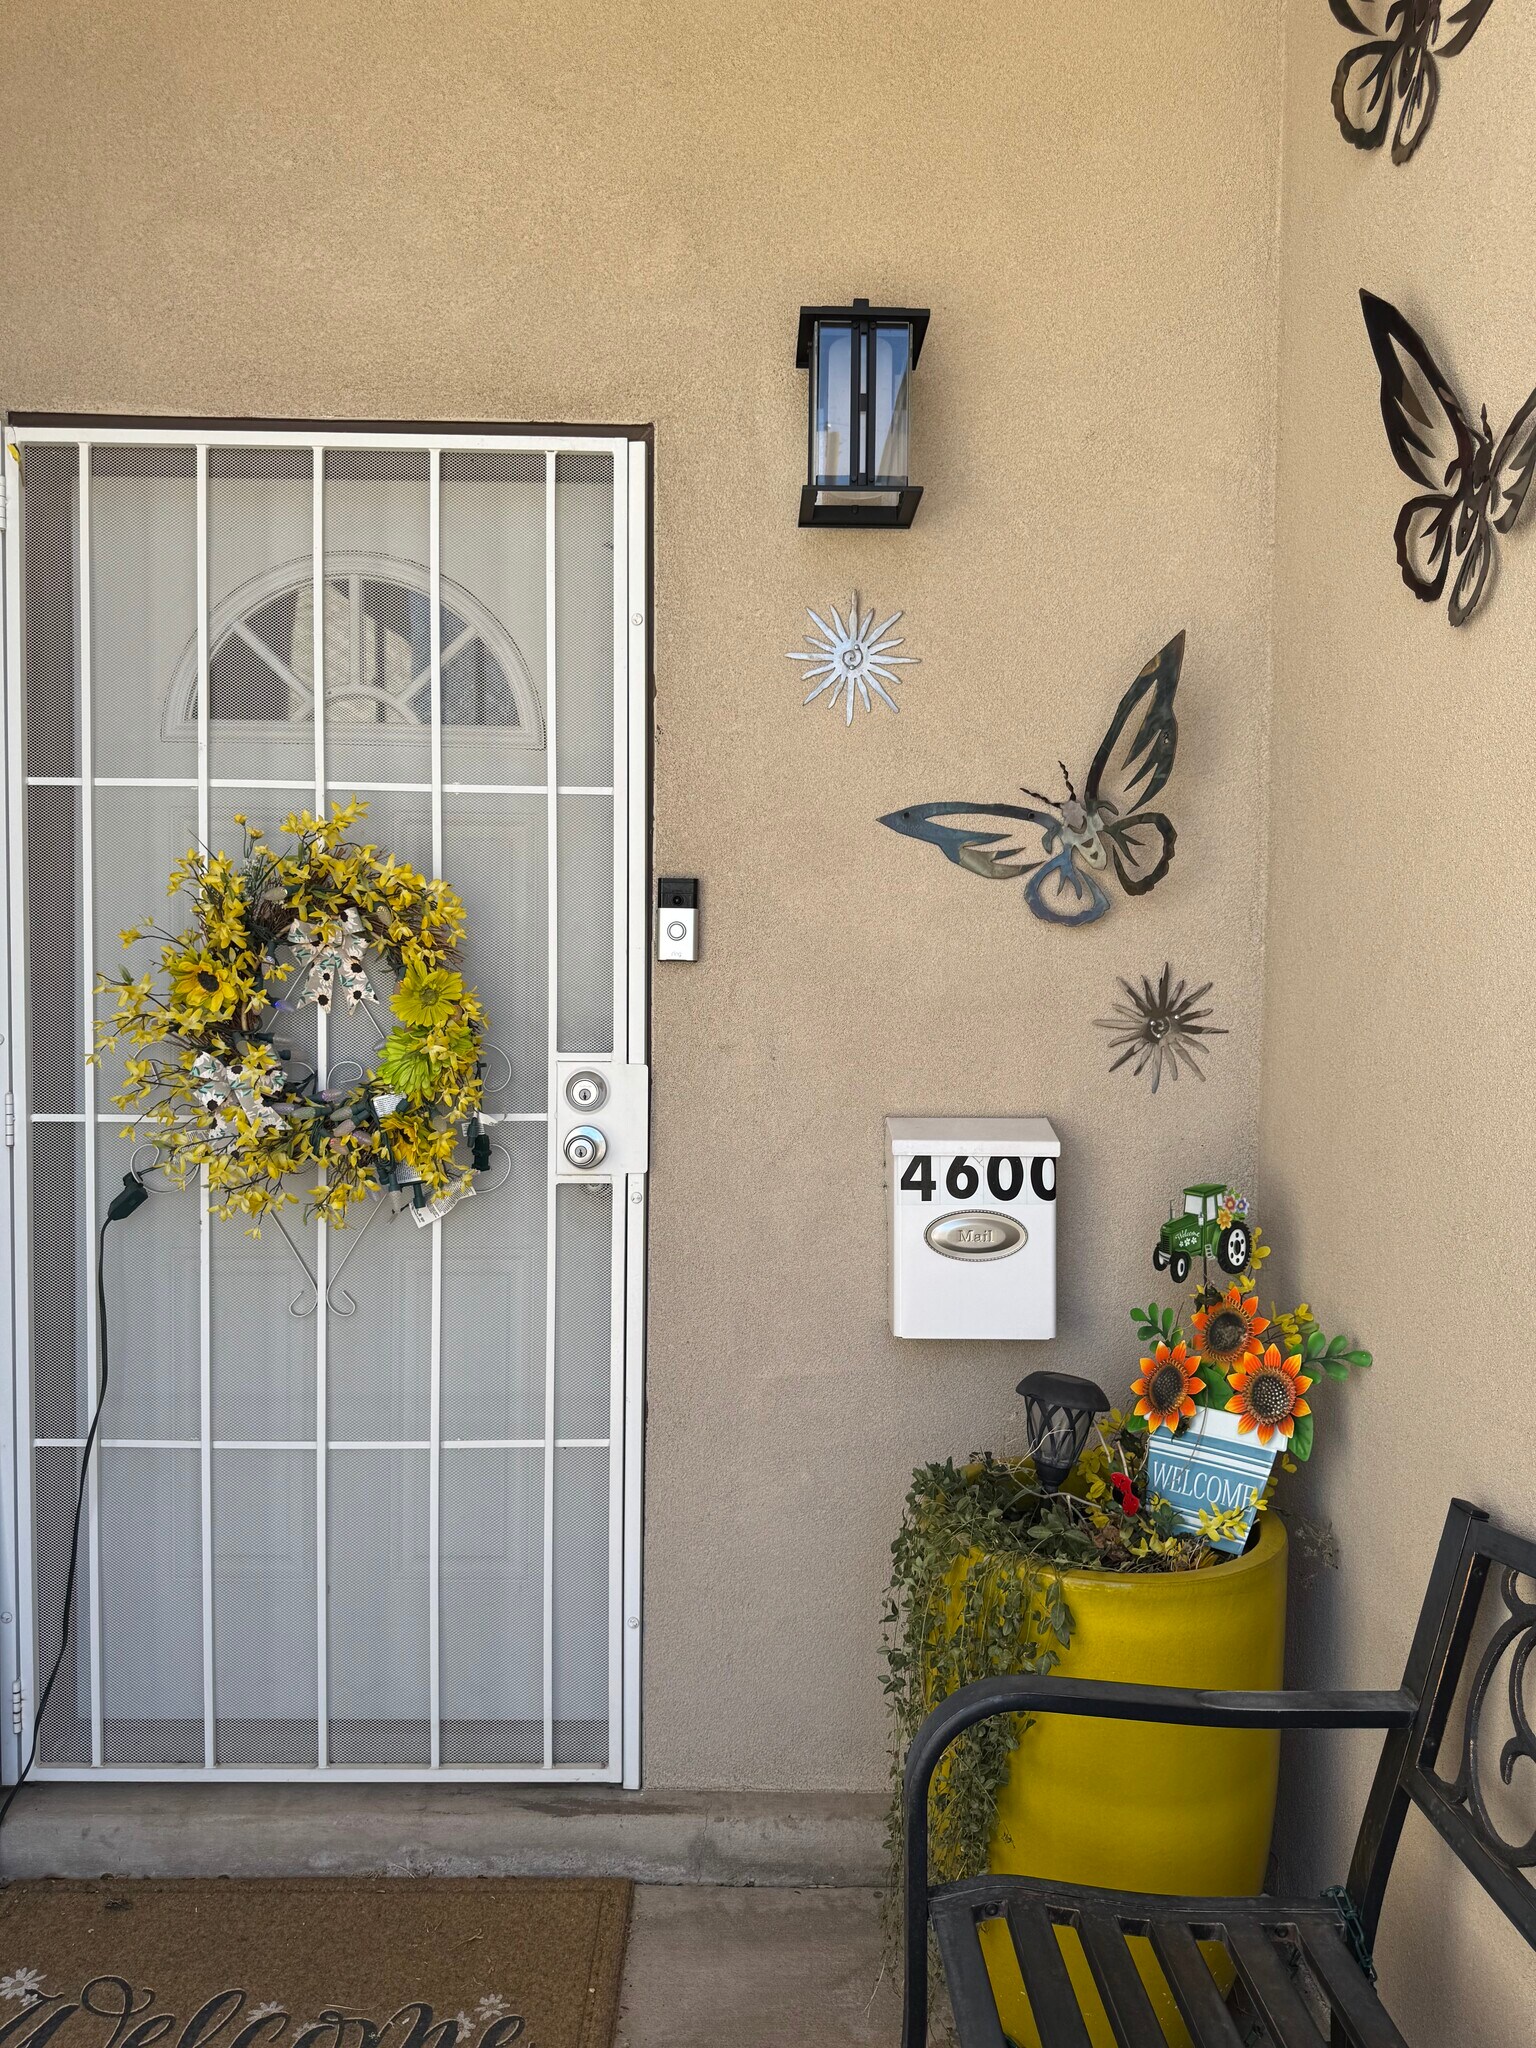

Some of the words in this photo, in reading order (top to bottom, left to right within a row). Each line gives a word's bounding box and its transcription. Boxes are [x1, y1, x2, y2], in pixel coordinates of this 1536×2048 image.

[900, 1156, 1057, 1202] 4600
[958, 1229, 994, 1243] Mail
[1175, 1229, 1200, 1240] Welcome
[1153, 1461, 1257, 1512] WELCOME
